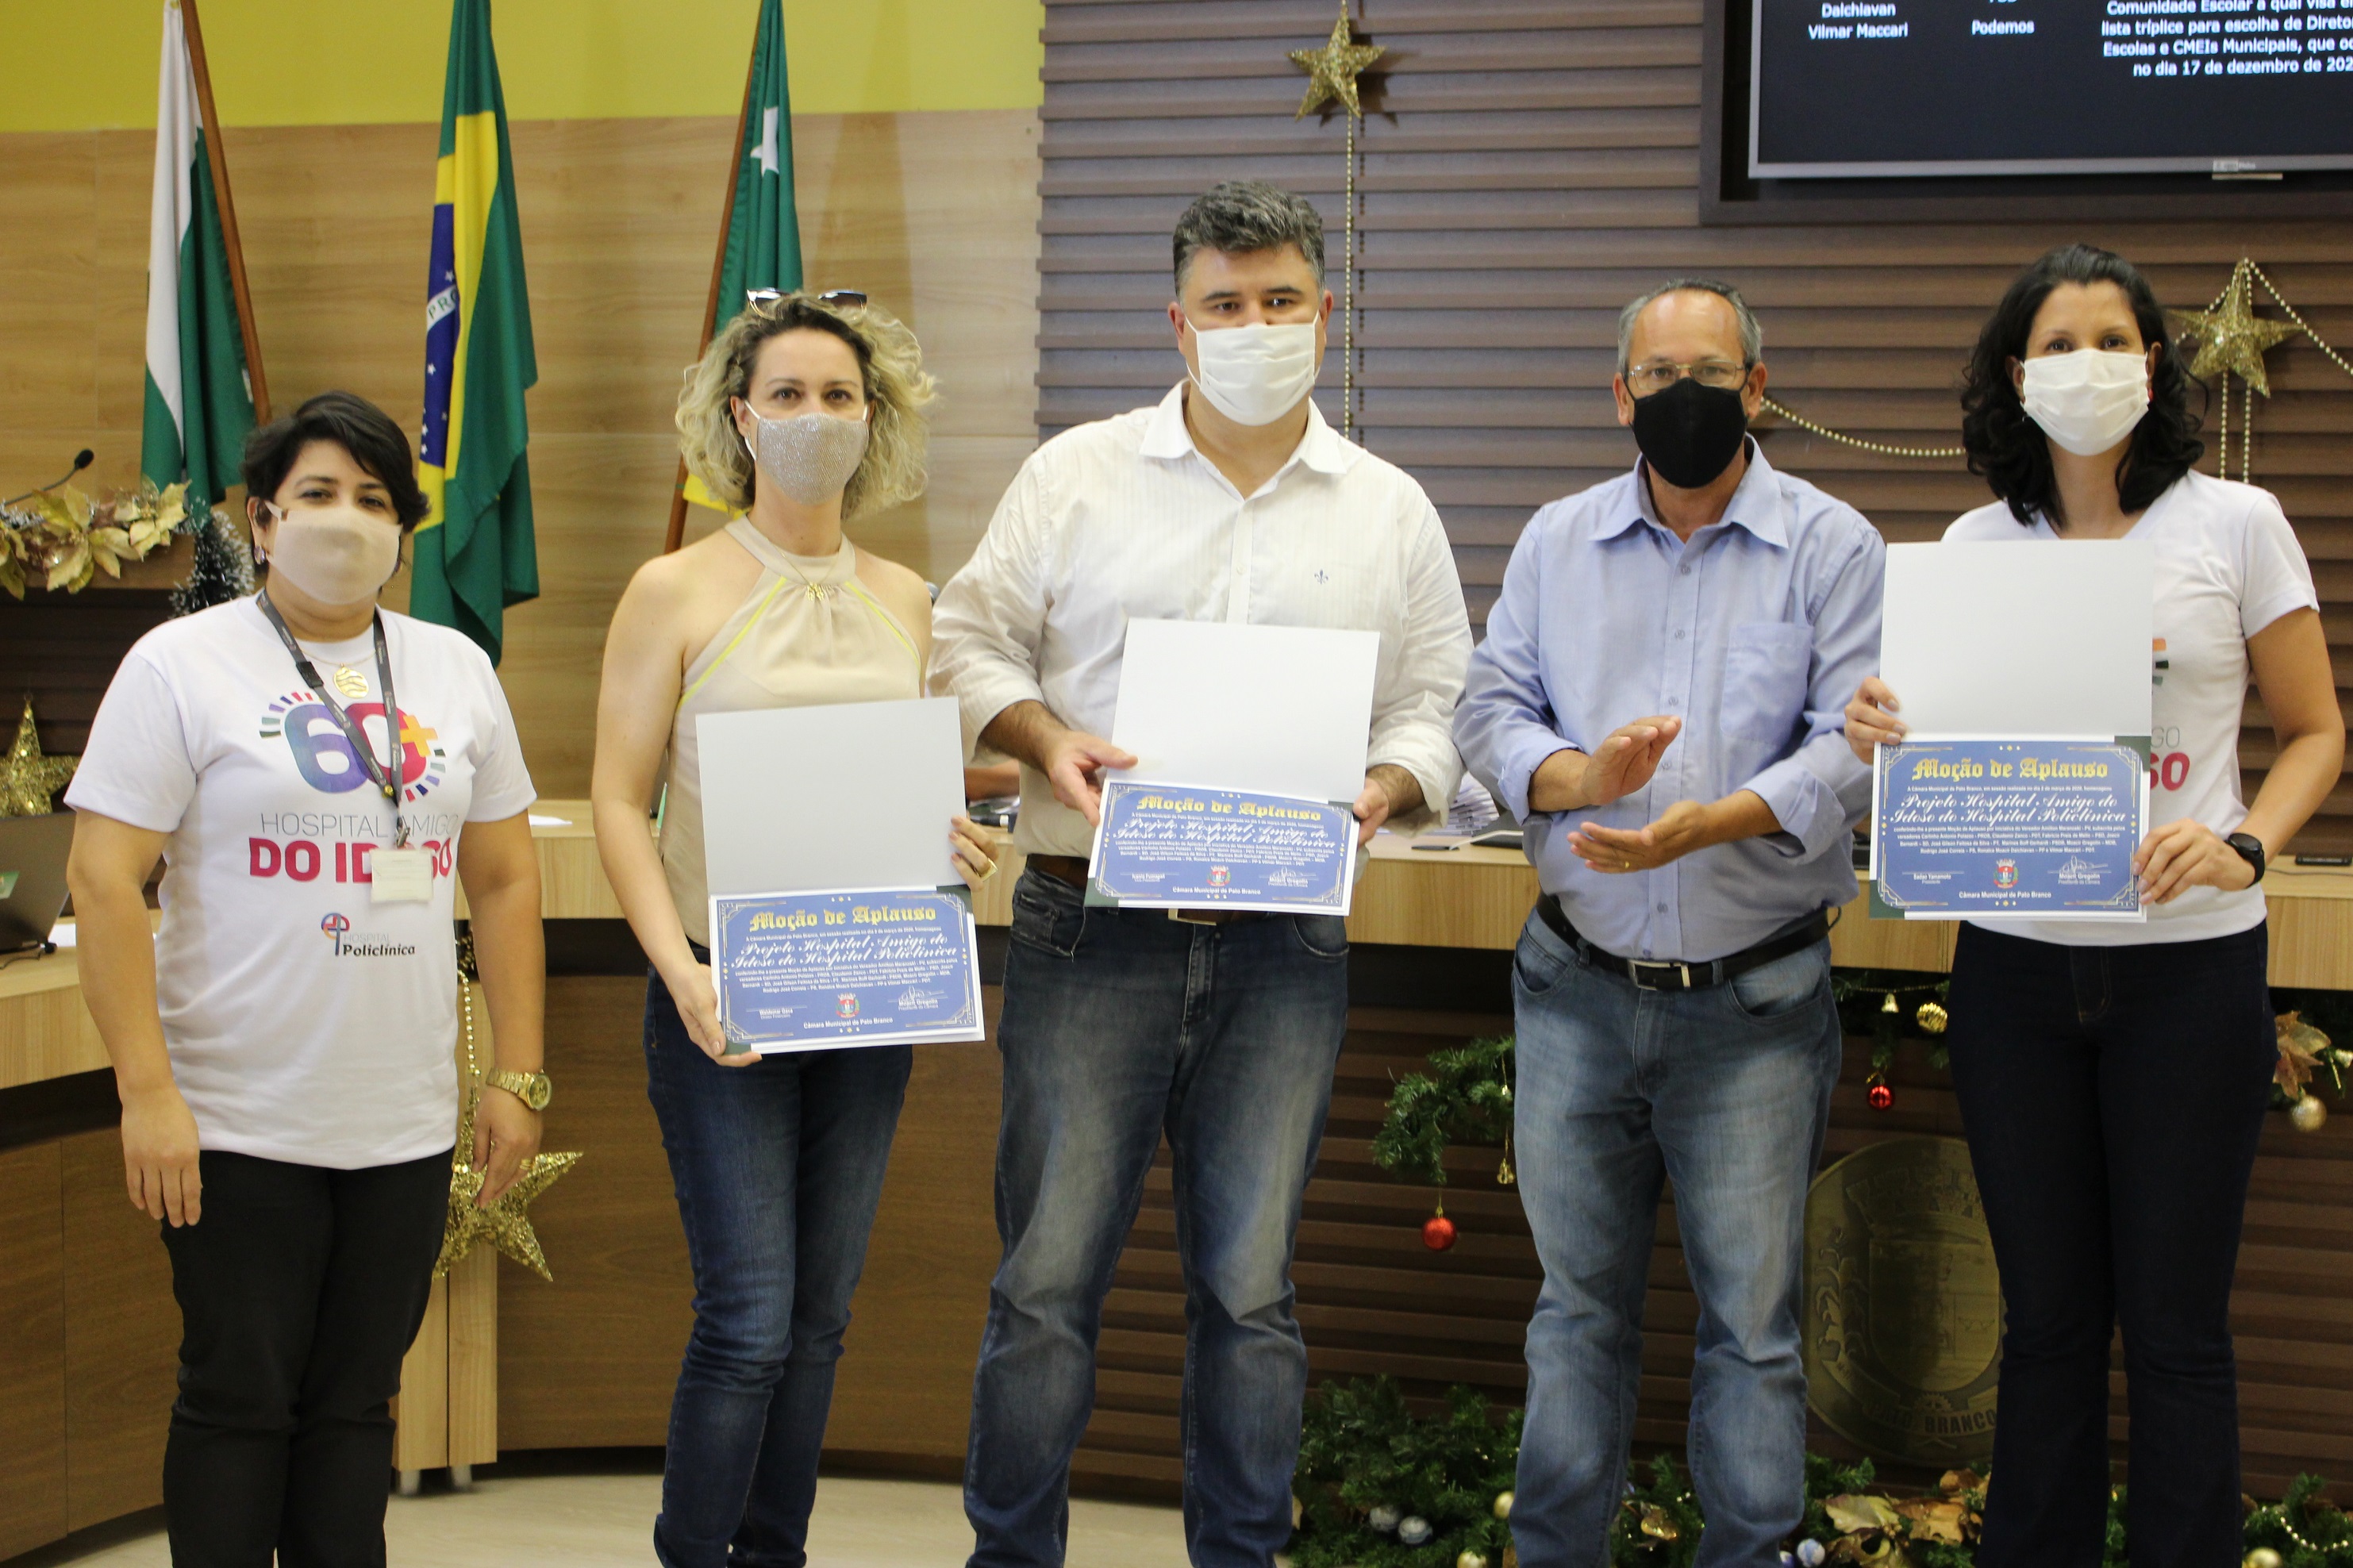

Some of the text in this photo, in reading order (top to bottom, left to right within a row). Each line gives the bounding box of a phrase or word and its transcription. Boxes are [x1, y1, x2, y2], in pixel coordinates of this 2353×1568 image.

[2106, 0, 2197, 16] Comunidade
[2201, 0, 2254, 13] Escolar
[2256, 0, 2266, 12] a
[1808, 21, 1908, 40] Vilmar Maccari
[1971, 18, 2035, 36] Podemos
[2101, 20, 2132, 37] lista
[2188, 21, 2220, 37] para
[2224, 15, 2280, 33] escolha
[2283, 14, 2303, 32] de
[2305, 13, 2353, 31] Direto
[2102, 40, 2156, 57] Escolas
[2159, 42, 2170, 56] e
[2172, 38, 2219, 56] CMEIs
[2222, 37, 2303, 55] Municipais,
[2307, 37, 2336, 54] que
[2132, 63, 2152, 77] no
[2155, 60, 2178, 76] dia
[2182, 60, 2201, 76] 17
[2204, 59, 2224, 75] de
[2226, 57, 2300, 75] dezembro
[2303, 56, 2323, 73] de
[1912, 758, 2108, 782] Moção de Aplauso
[1136, 795, 1205, 813] Moção
[1211, 800, 1233, 813] de
[1239, 802, 1321, 821] Aplauso
[1901, 793, 2117, 814] Projeto Hospital Amigo do
[260, 813, 388, 838] HOSPITAL
[1939, 809, 1957, 823] do
[1961, 808, 2036, 828] Hospital
[248, 836, 452, 883] DO IDSO
[1981, 890, 2009, 900] Municipal
[750, 905, 936, 932] Moção de Aplauso
[343, 943, 416, 956] Policlínica
[799, 935, 871, 955] Hospital
[871, 934, 927, 954] Amigo
[930, 932, 948, 946] do
[779, 954, 796, 967] do
[800, 947, 872, 967] Hospital
[825, 1019, 852, 1028] Municipal
[1924, 1409, 1997, 1434] BRANCO
